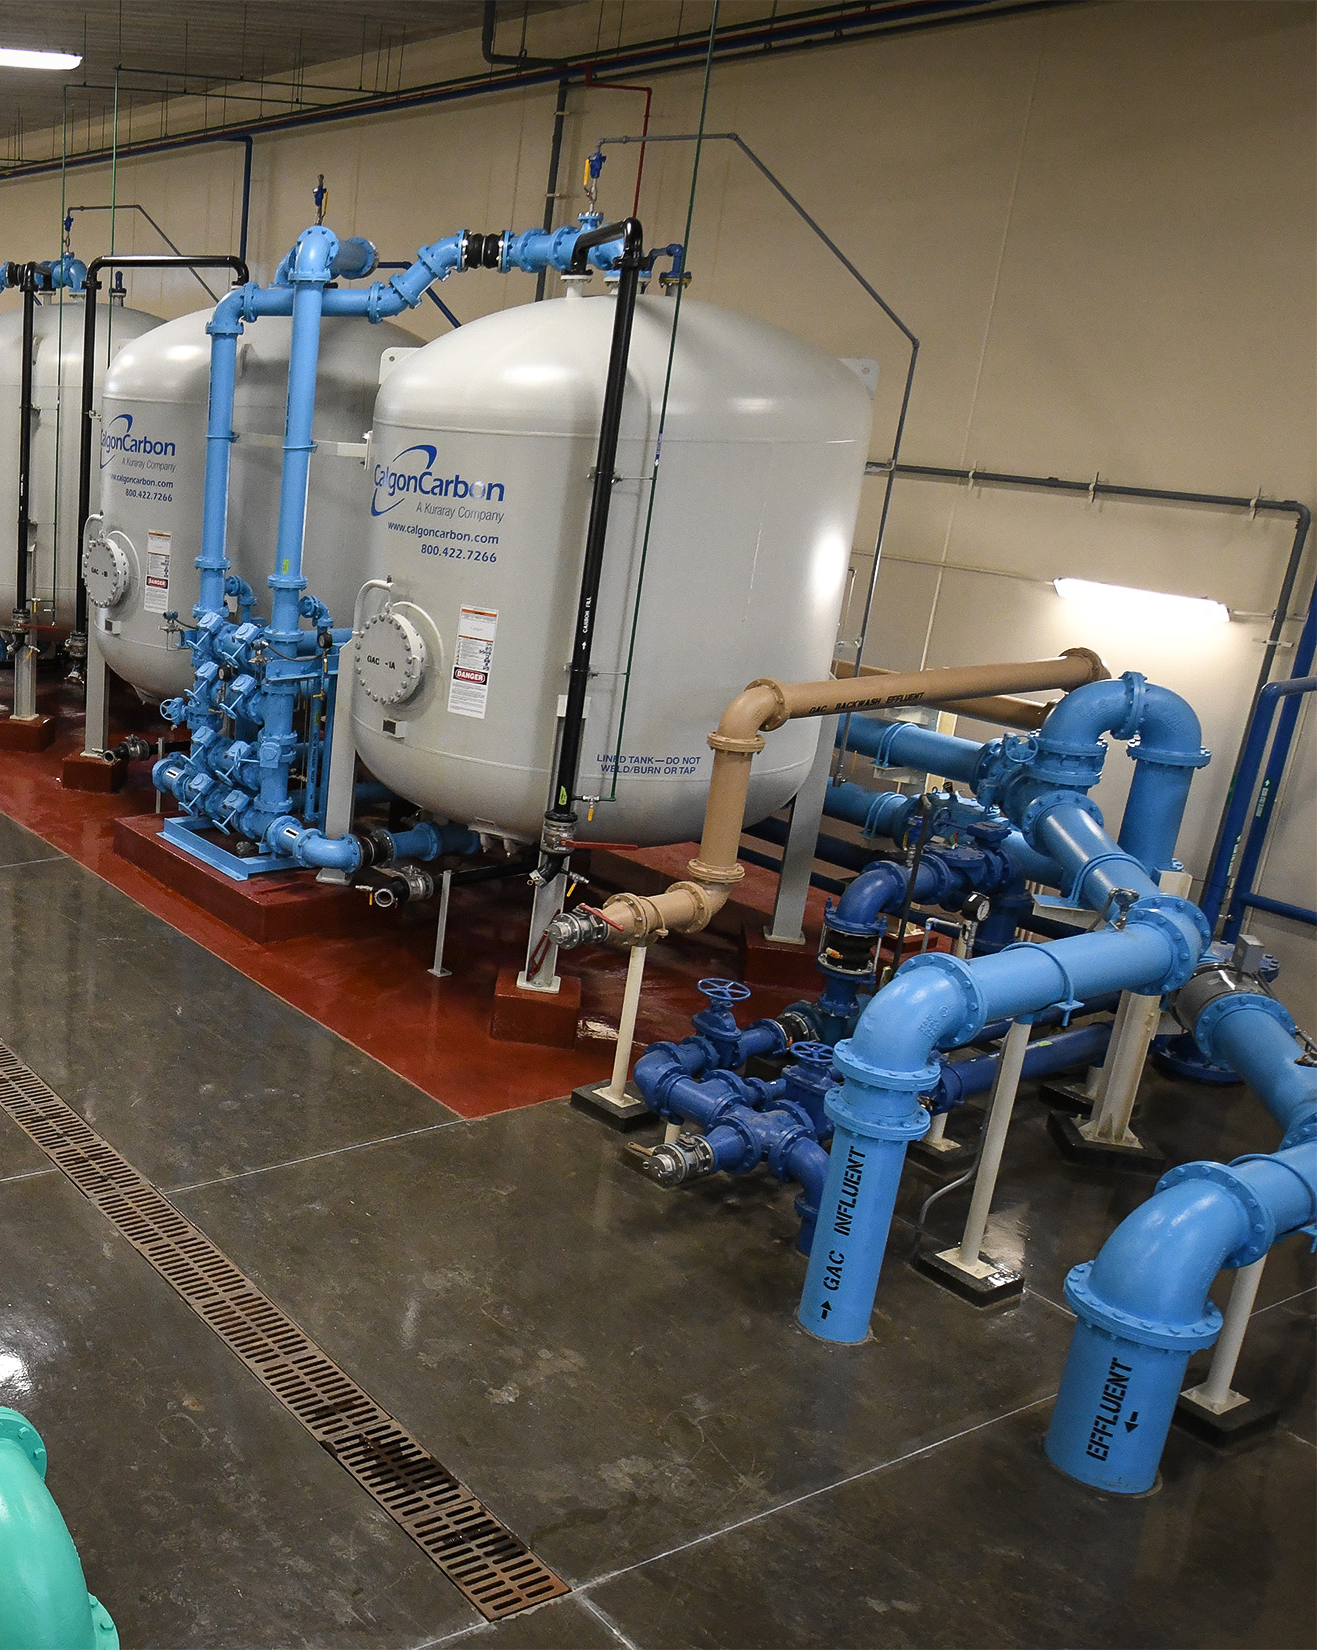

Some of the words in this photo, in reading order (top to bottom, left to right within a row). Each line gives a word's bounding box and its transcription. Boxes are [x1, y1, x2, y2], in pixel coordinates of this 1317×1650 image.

[146, 460, 177, 474] Company
[374, 464, 504, 502] CalgonCarbon
[125, 488, 173, 502] 800.422.7266
[416, 502, 423, 513] A
[424, 503, 456, 520] Kuraray
[457, 506, 505, 524] Company
[387, 521, 499, 544] www.calgoncarbon.com
[421, 544, 497, 563] 800.422.7266
[457, 670, 484, 683] DANGER
[809, 705, 827, 714] GAC
[835, 697, 881, 710] BACKWASH
[886, 692, 925, 704] EFFLUENT
[663, 766, 678, 775] OR
[679, 766, 697, 775] TAP
[682, 756, 701, 765] NOT
[823, 1249, 845, 1291] GAC
[834, 1145, 866, 1237] INFLUENT
[1086, 1356, 1133, 1462] EFFLUENT
